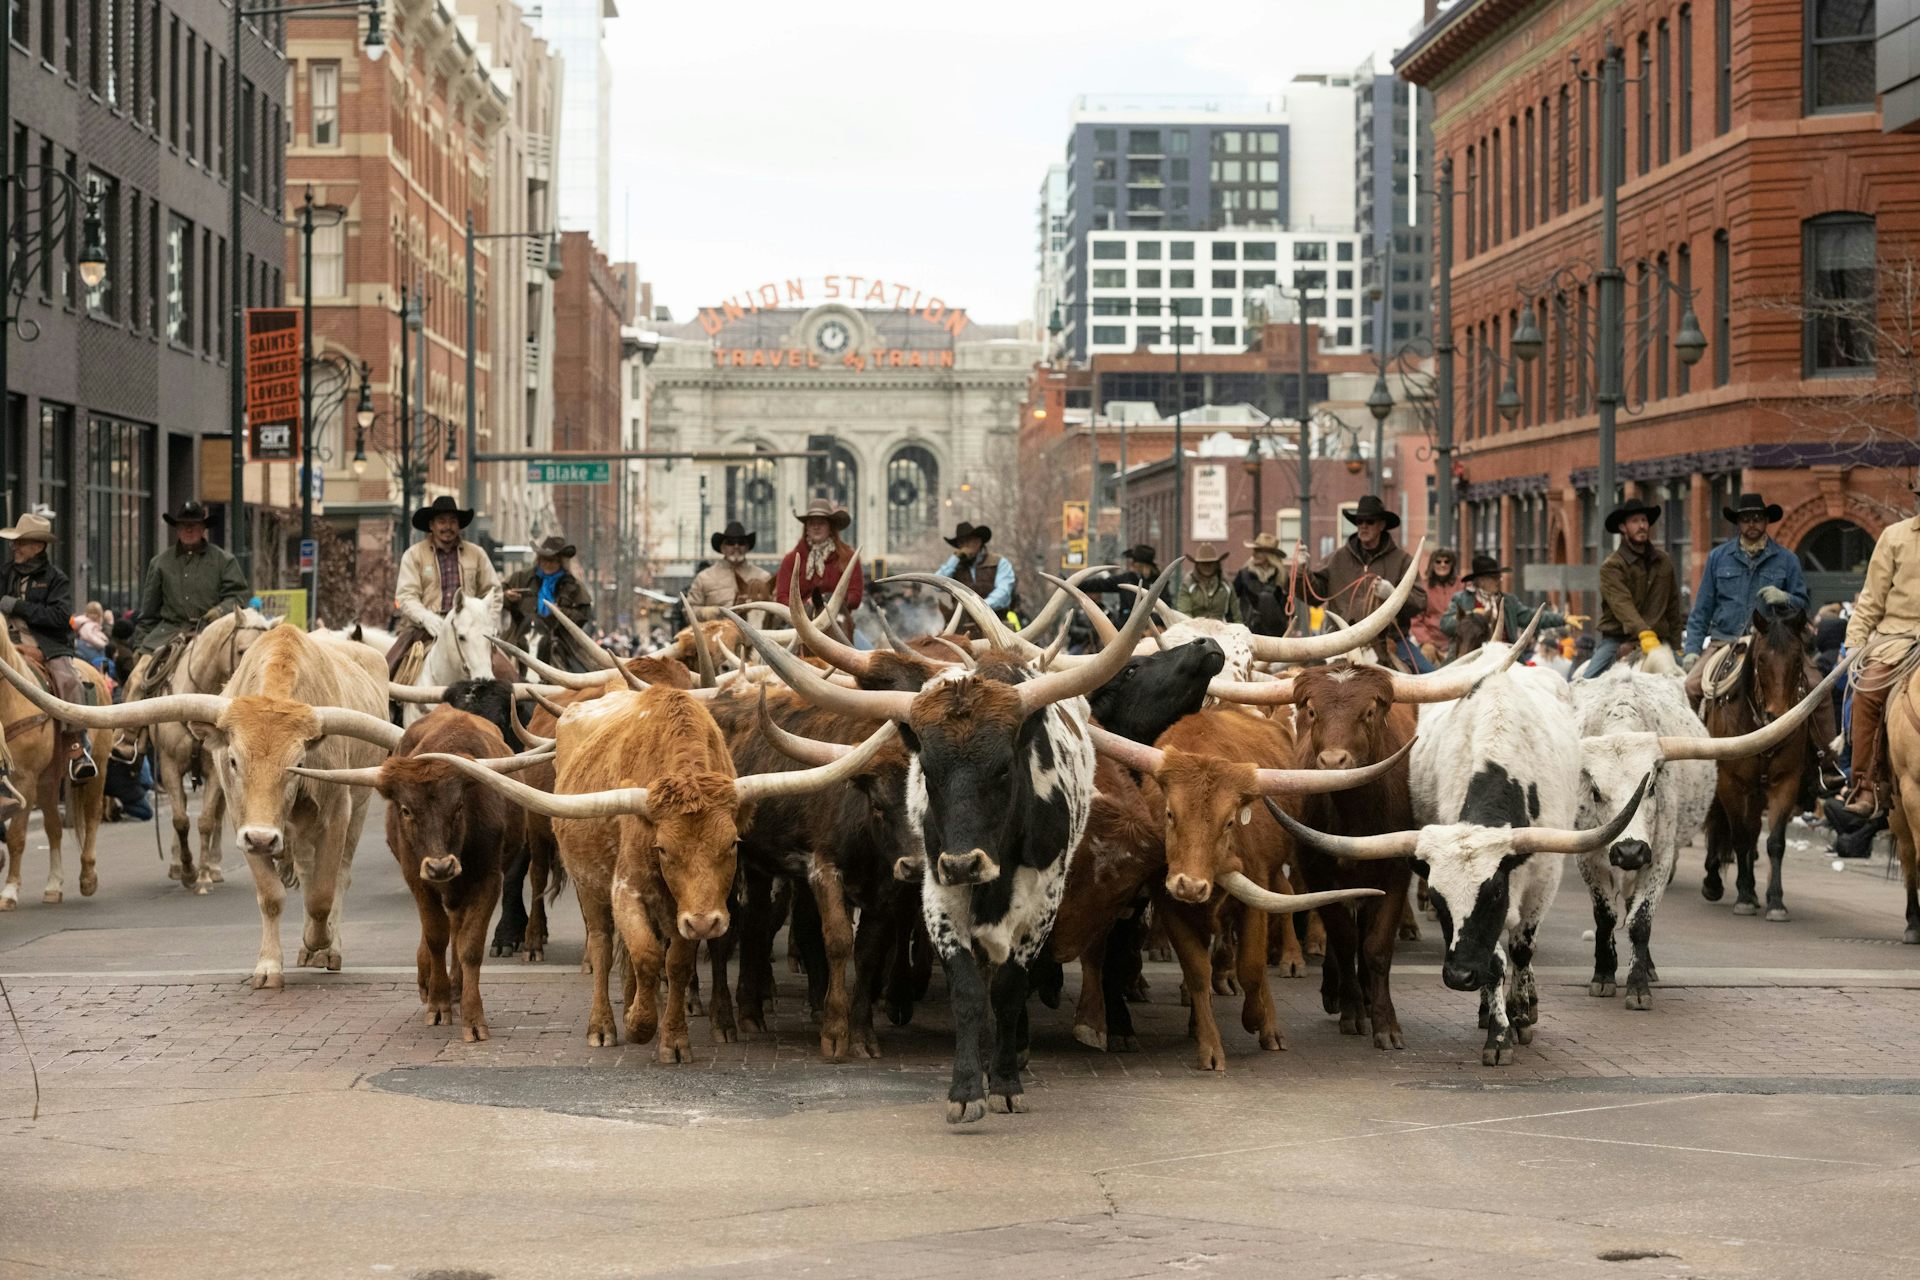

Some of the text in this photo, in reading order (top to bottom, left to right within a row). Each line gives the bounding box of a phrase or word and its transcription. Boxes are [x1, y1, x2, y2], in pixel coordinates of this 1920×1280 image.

[699, 275, 968, 337] UNION STATION
[250, 332, 295, 354] SAINTS
[250, 358, 295, 377] SINNERS
[713, 349, 820, 368] TRAVEL
[872, 349, 955, 368] TRAIN
[251, 382, 295, 401] LOVERS
[260, 425, 291, 444] art
[546, 464, 588, 481] Blake
